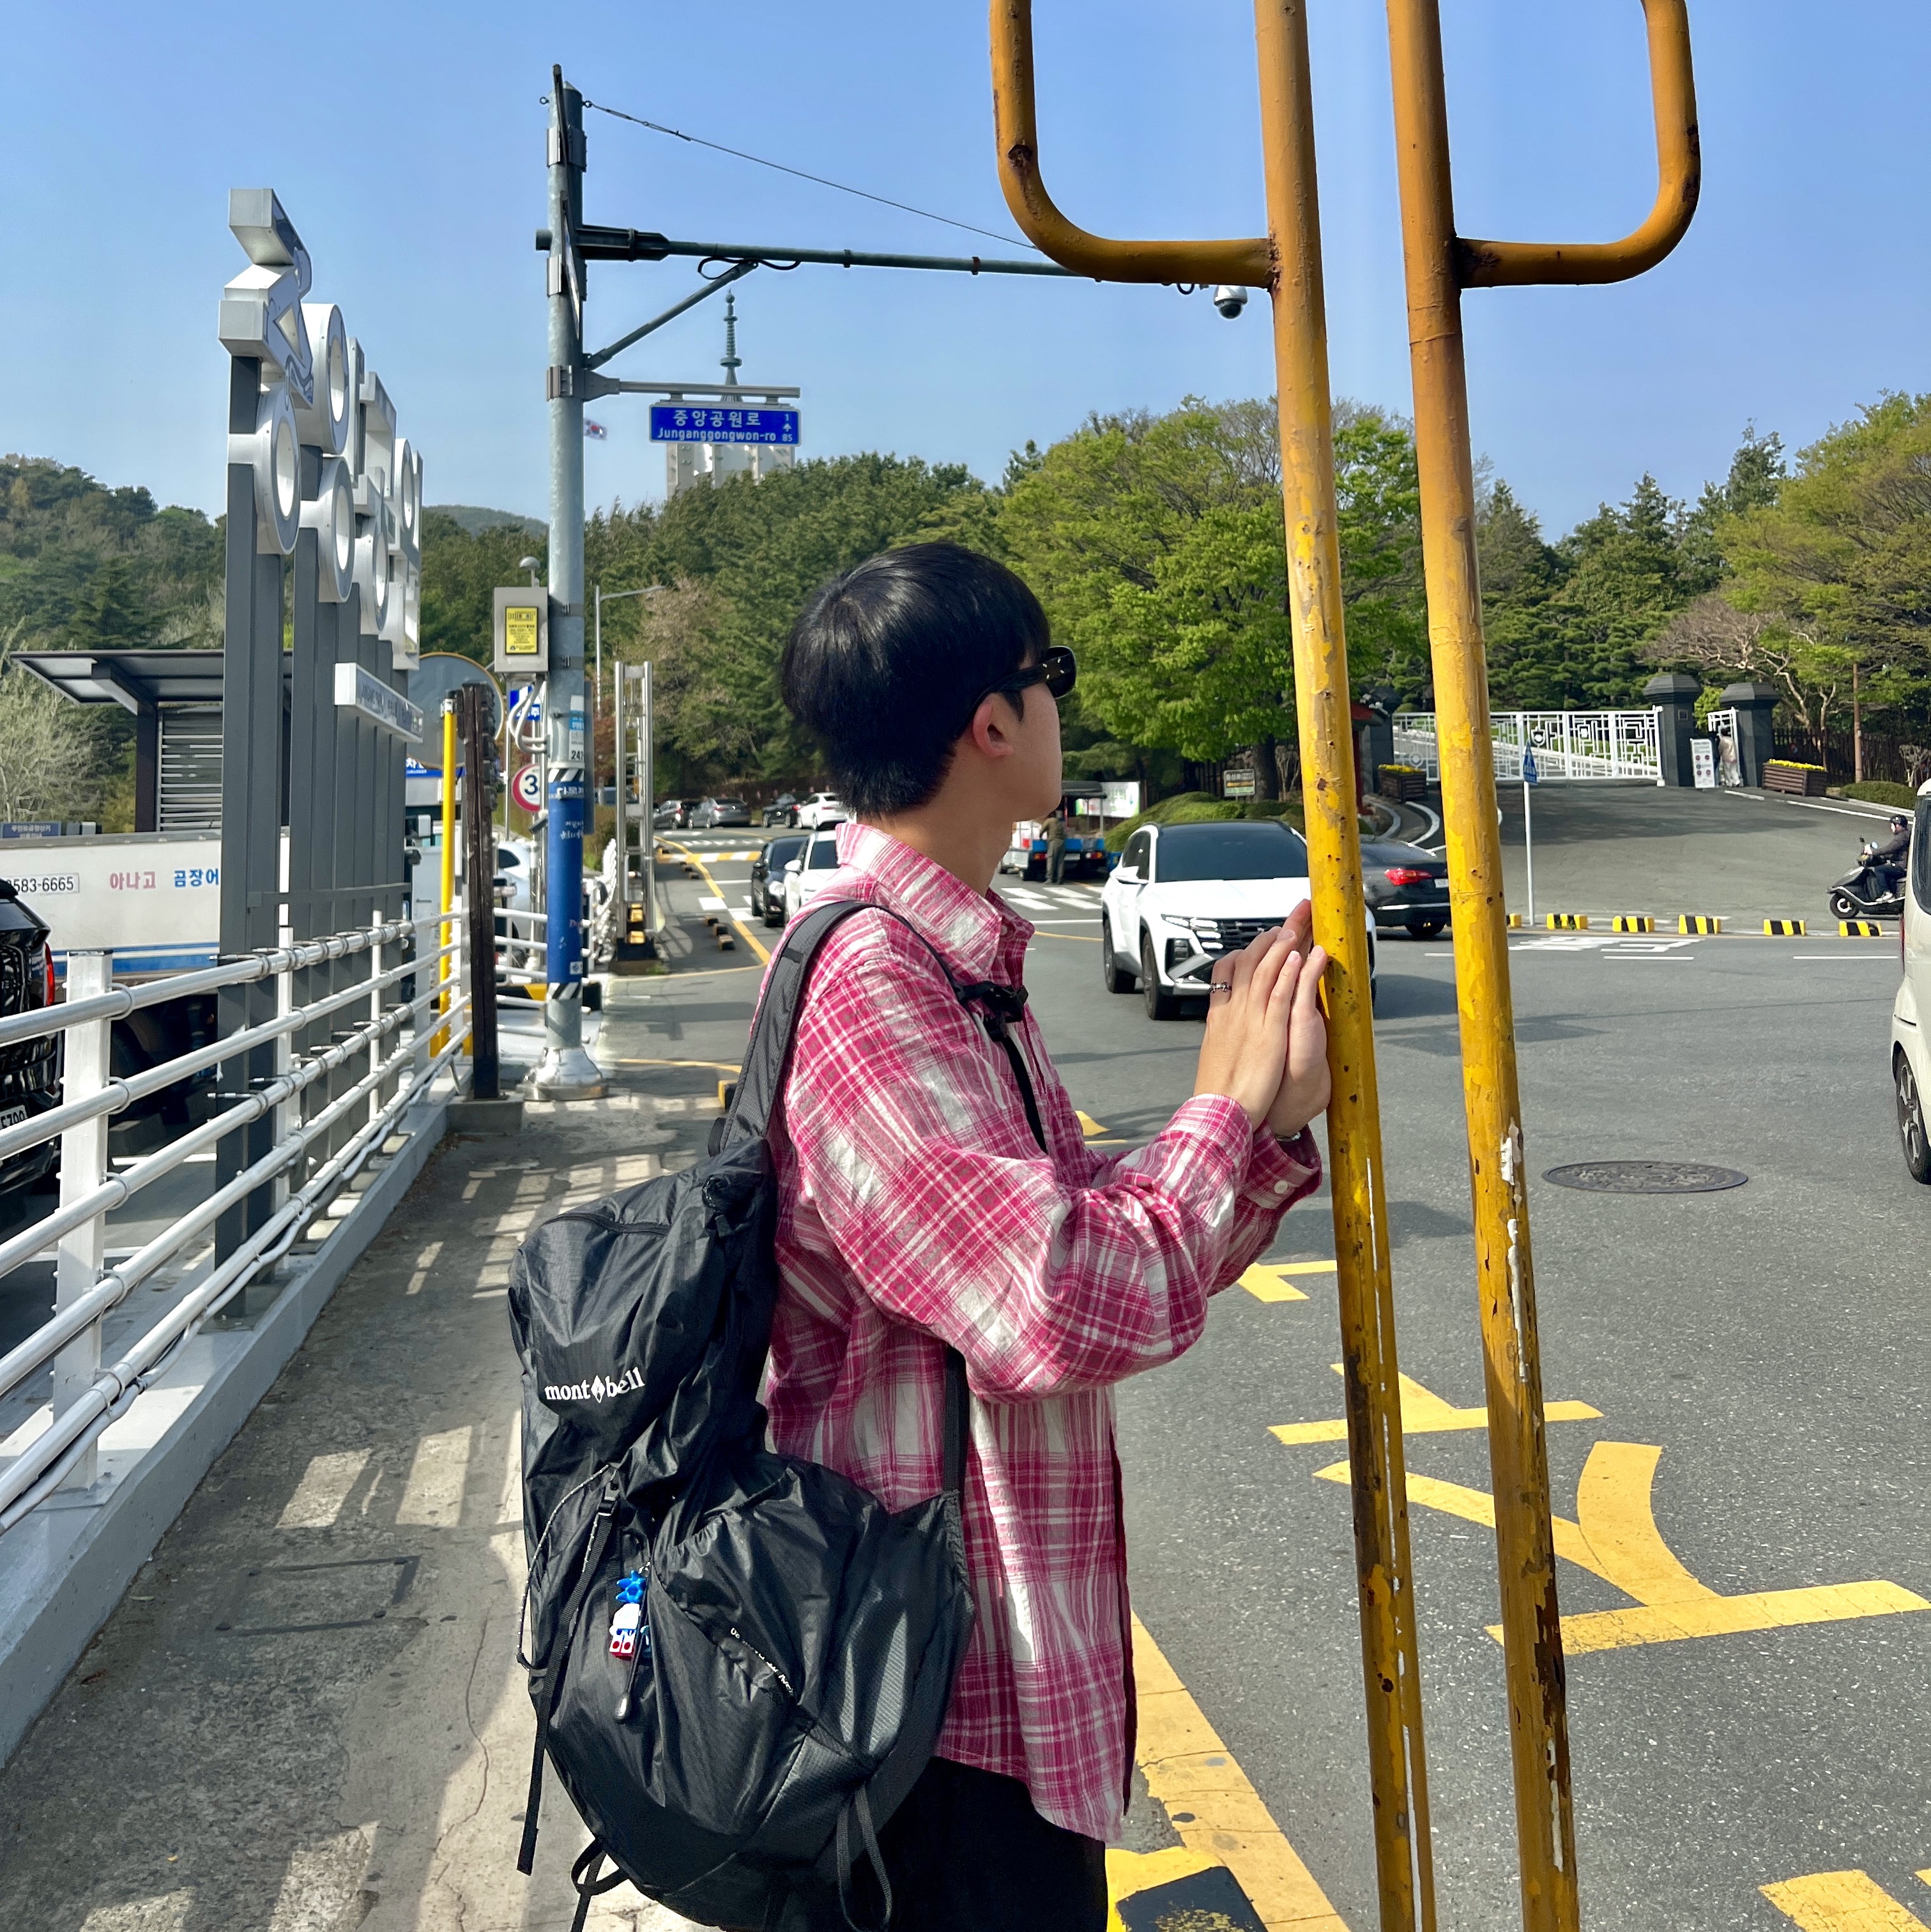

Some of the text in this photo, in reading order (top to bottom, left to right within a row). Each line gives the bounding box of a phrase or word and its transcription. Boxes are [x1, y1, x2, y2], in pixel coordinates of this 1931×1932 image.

[673, 410, 761, 428] 중앙공원로
[784, 413, 790, 422] 1
[657, 427, 777, 441] Junganggongwon-ro
[782, 433, 793, 442] 85
[109, 868, 219, 890] 아나고 곰장어
